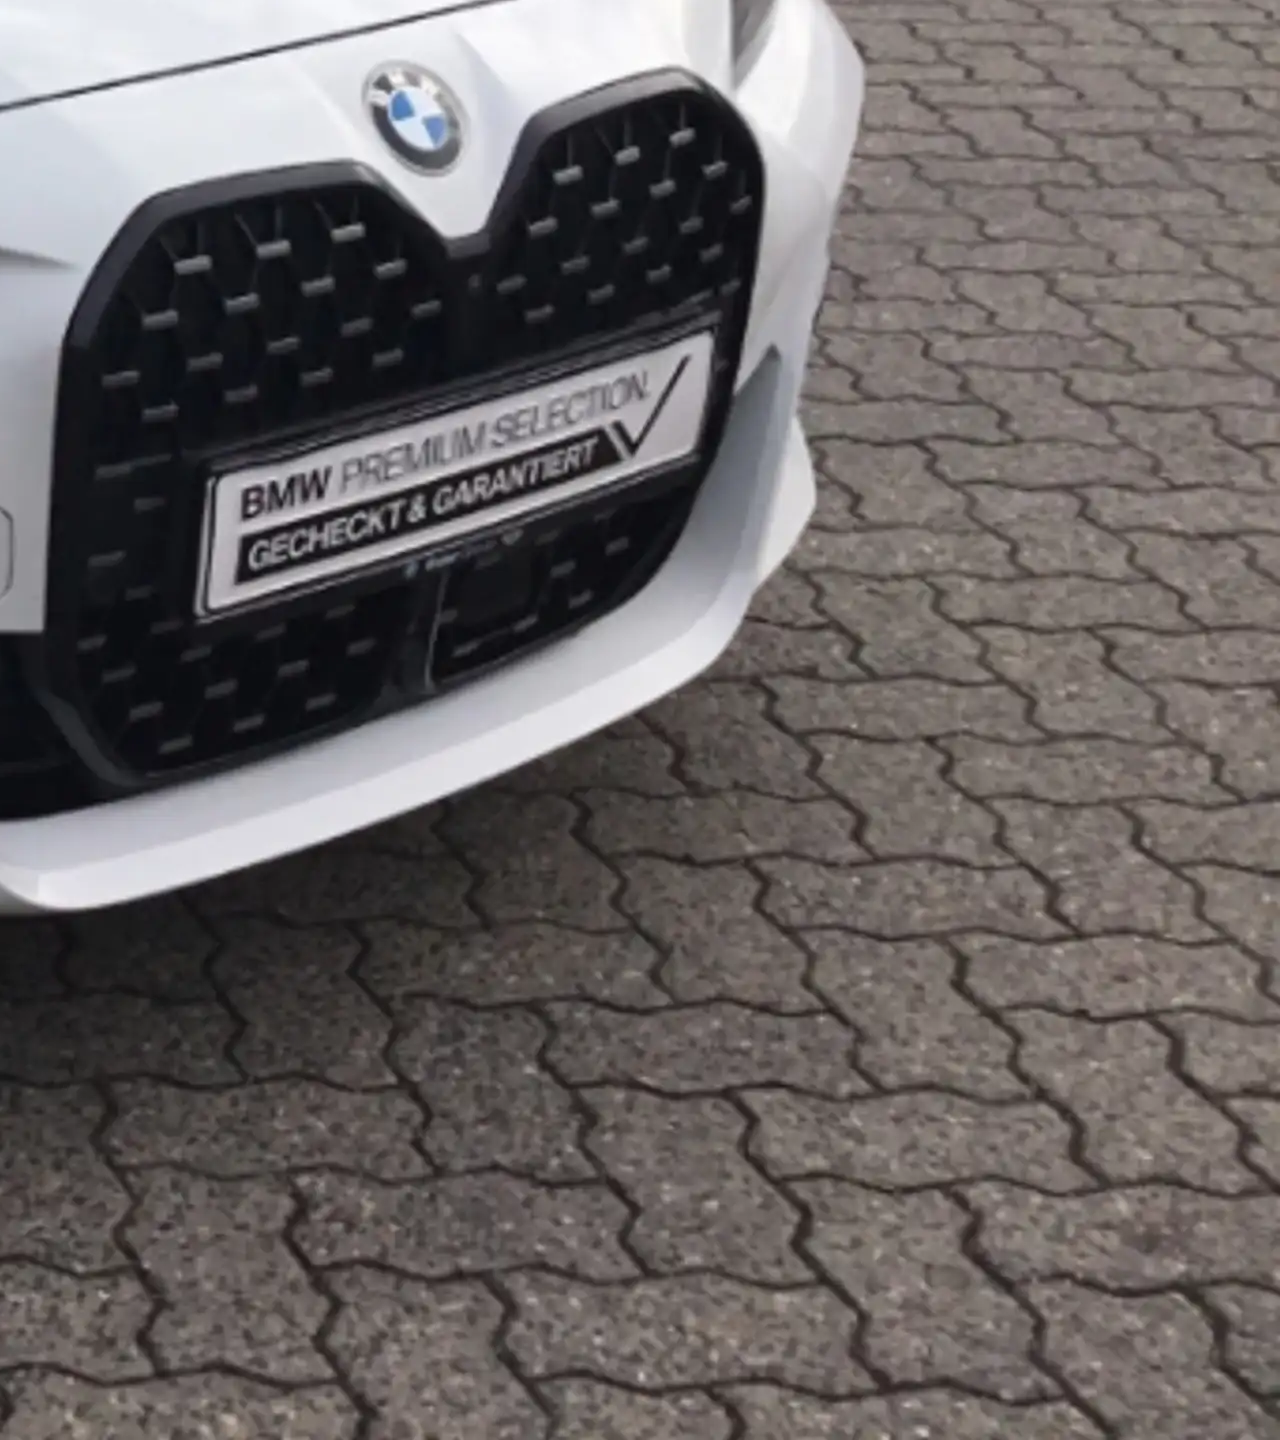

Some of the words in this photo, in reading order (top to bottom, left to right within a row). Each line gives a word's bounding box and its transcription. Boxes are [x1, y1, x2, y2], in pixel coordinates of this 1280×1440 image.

[241, 465, 333, 521] BMW
[341, 420, 487, 493] PREMIUM
[492, 370, 649, 449] SELECTION
[248, 498, 407, 572] GECHECKT
[406, 494, 428, 523] &
